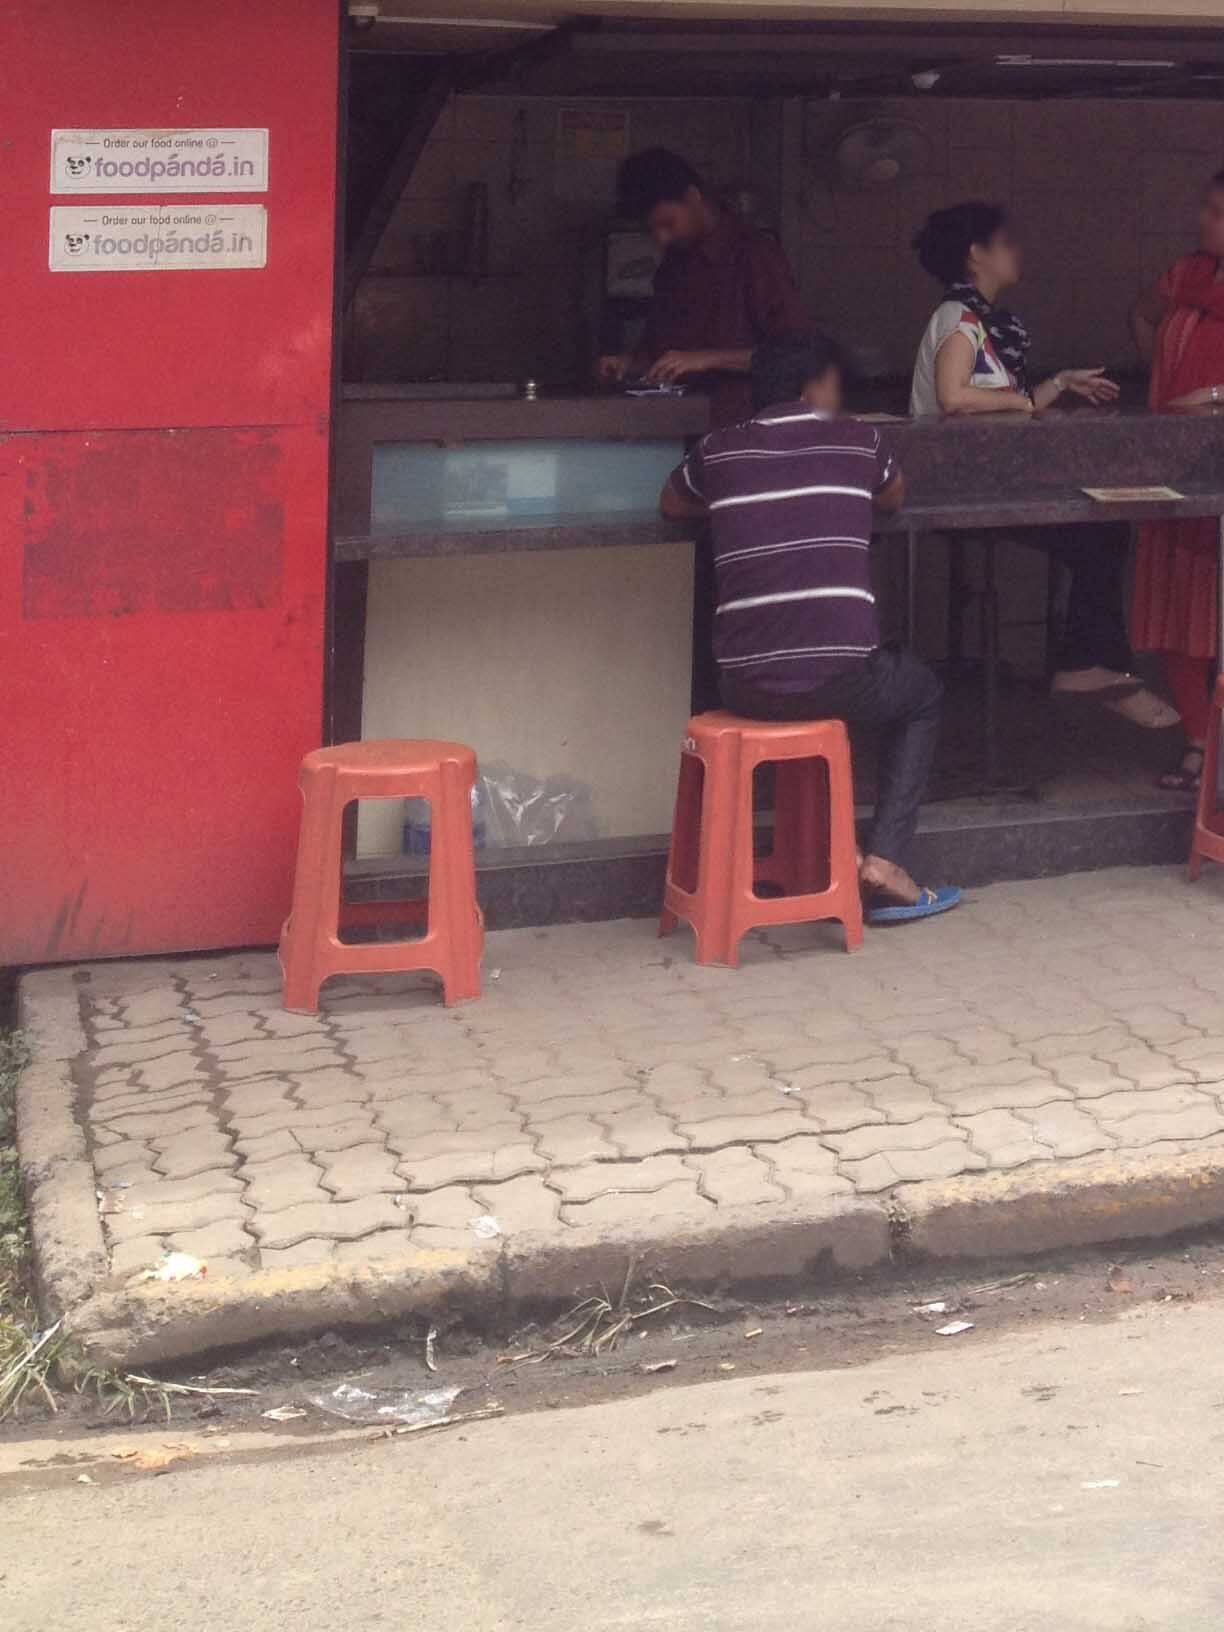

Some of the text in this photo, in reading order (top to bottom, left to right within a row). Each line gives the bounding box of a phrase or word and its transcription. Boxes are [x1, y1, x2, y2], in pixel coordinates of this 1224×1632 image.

[103, 138, 130, 148] Order
[132, 140, 149, 149] our
[151, 137, 172, 148] food
[175, 137, 203, 148] online
[102, 215, 128, 226] Order
[131, 217, 146, 225] our
[150, 215, 171, 225] food
[173, 214, 202, 225] online
